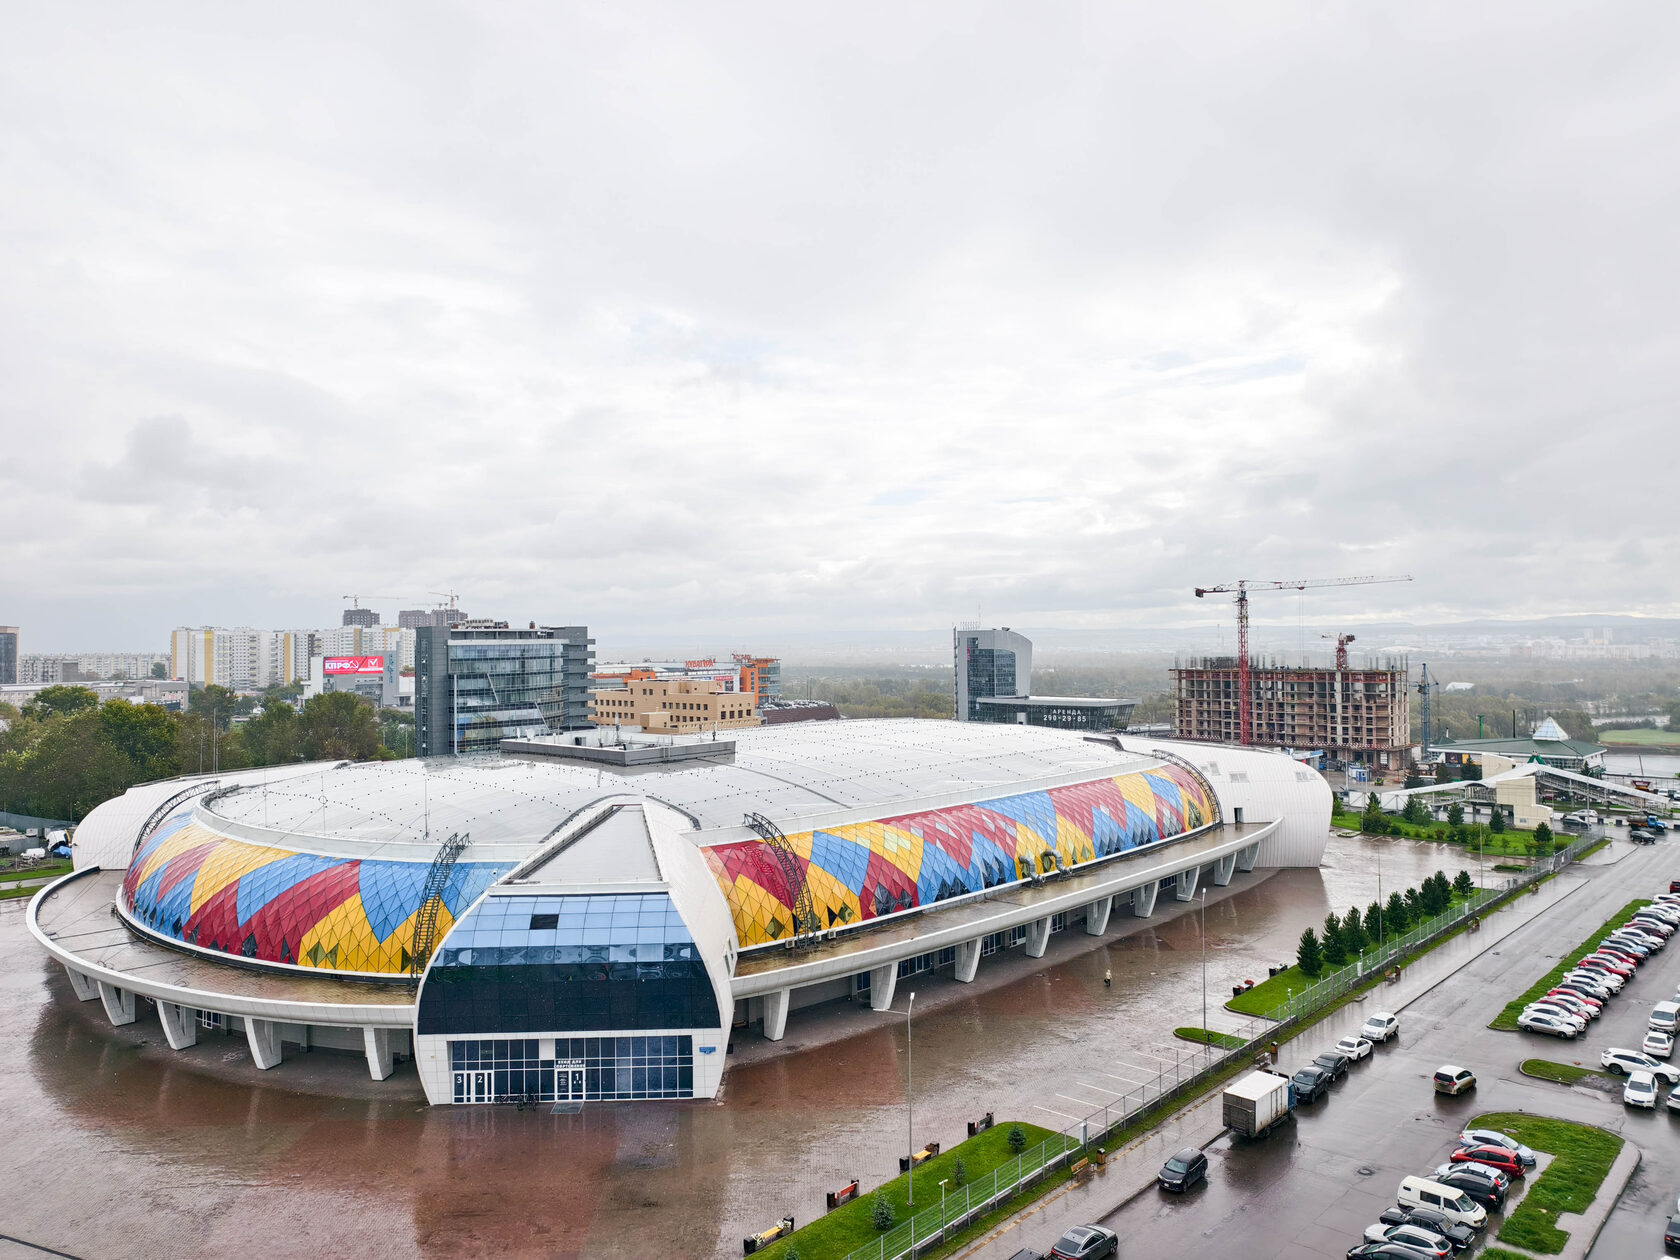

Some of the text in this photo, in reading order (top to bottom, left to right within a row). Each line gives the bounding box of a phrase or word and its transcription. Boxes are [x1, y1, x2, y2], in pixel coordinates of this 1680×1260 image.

[456, 1075, 463, 1084] 3
[477, 1075, 483, 1084] 2
[575, 1073, 579, 1081] 1
